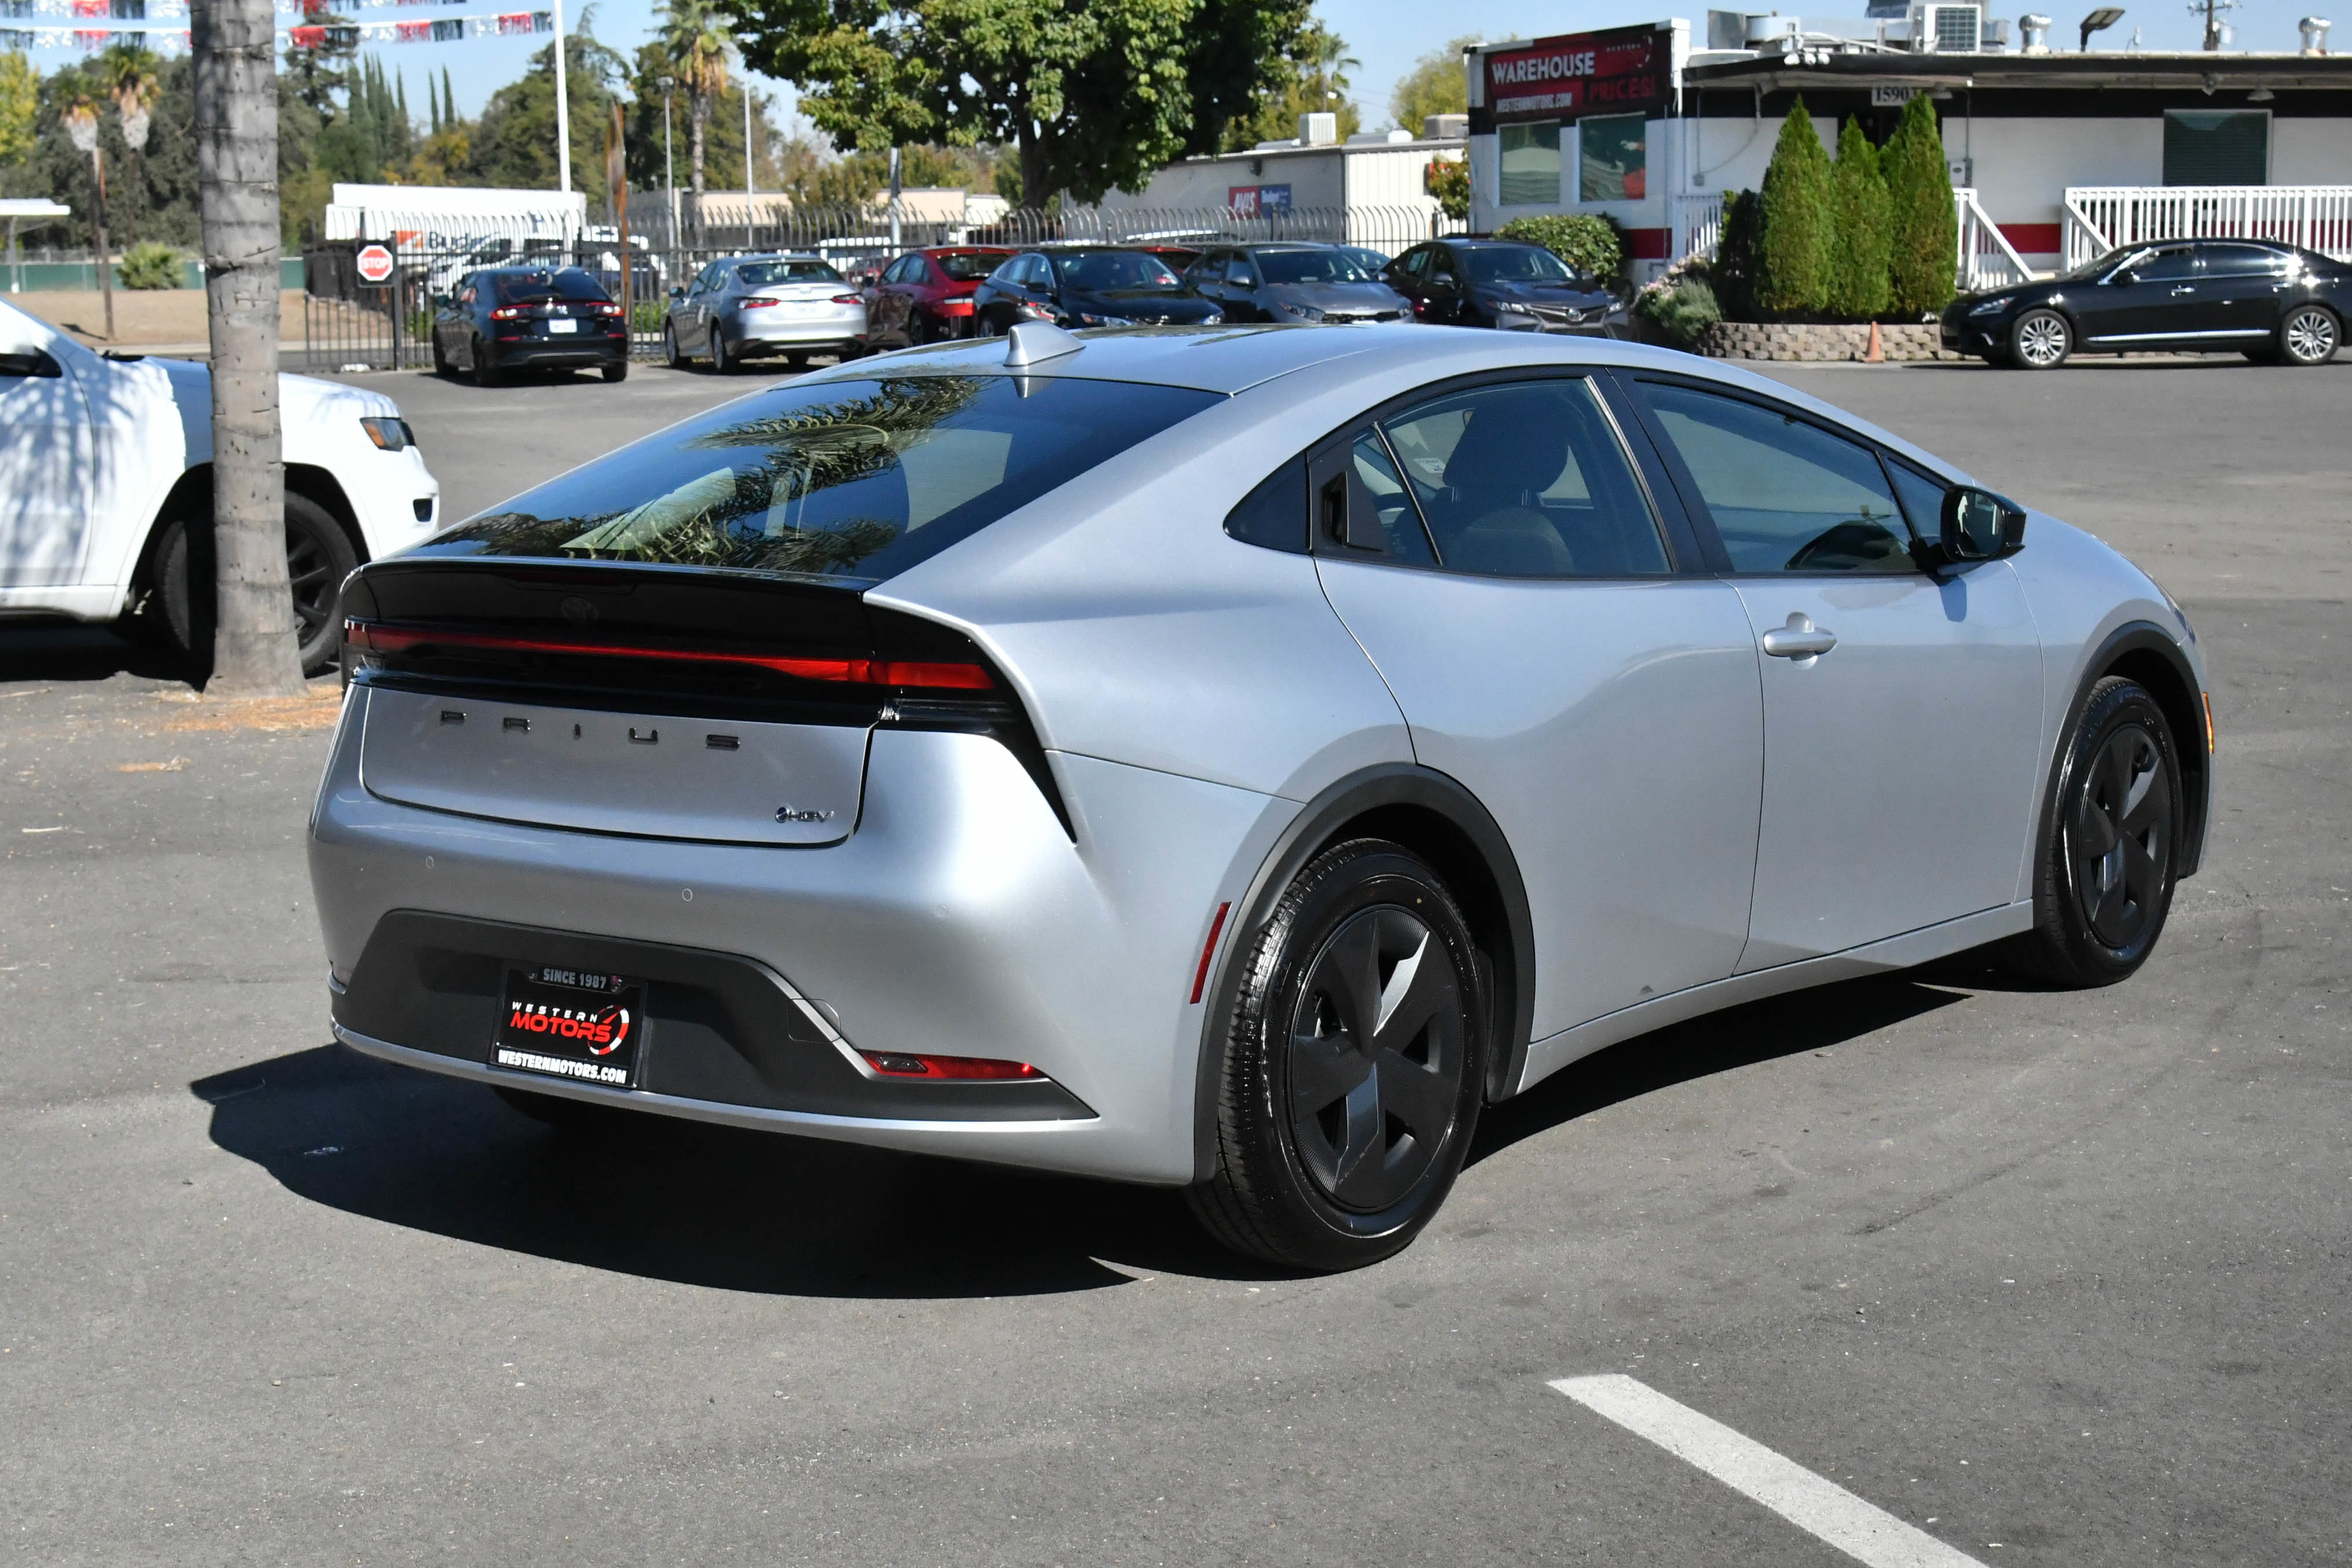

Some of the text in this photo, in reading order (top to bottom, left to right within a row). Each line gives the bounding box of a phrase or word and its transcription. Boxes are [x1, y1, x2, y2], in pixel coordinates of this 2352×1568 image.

[1492, 52, 1595, 85] WAREHOUSE
[1234, 192, 1256, 213] AVIS
[361, 257, 389, 269] STOP
[441, 710, 740, 749] PRIUS
[543, 968, 607, 989] SINCE 1987
[512, 1001, 598, 1023] WESTERN
[510, 1011, 612, 1043] MOTORS
[498, 1049, 627, 1084] WESTERNMOTORS.COM
